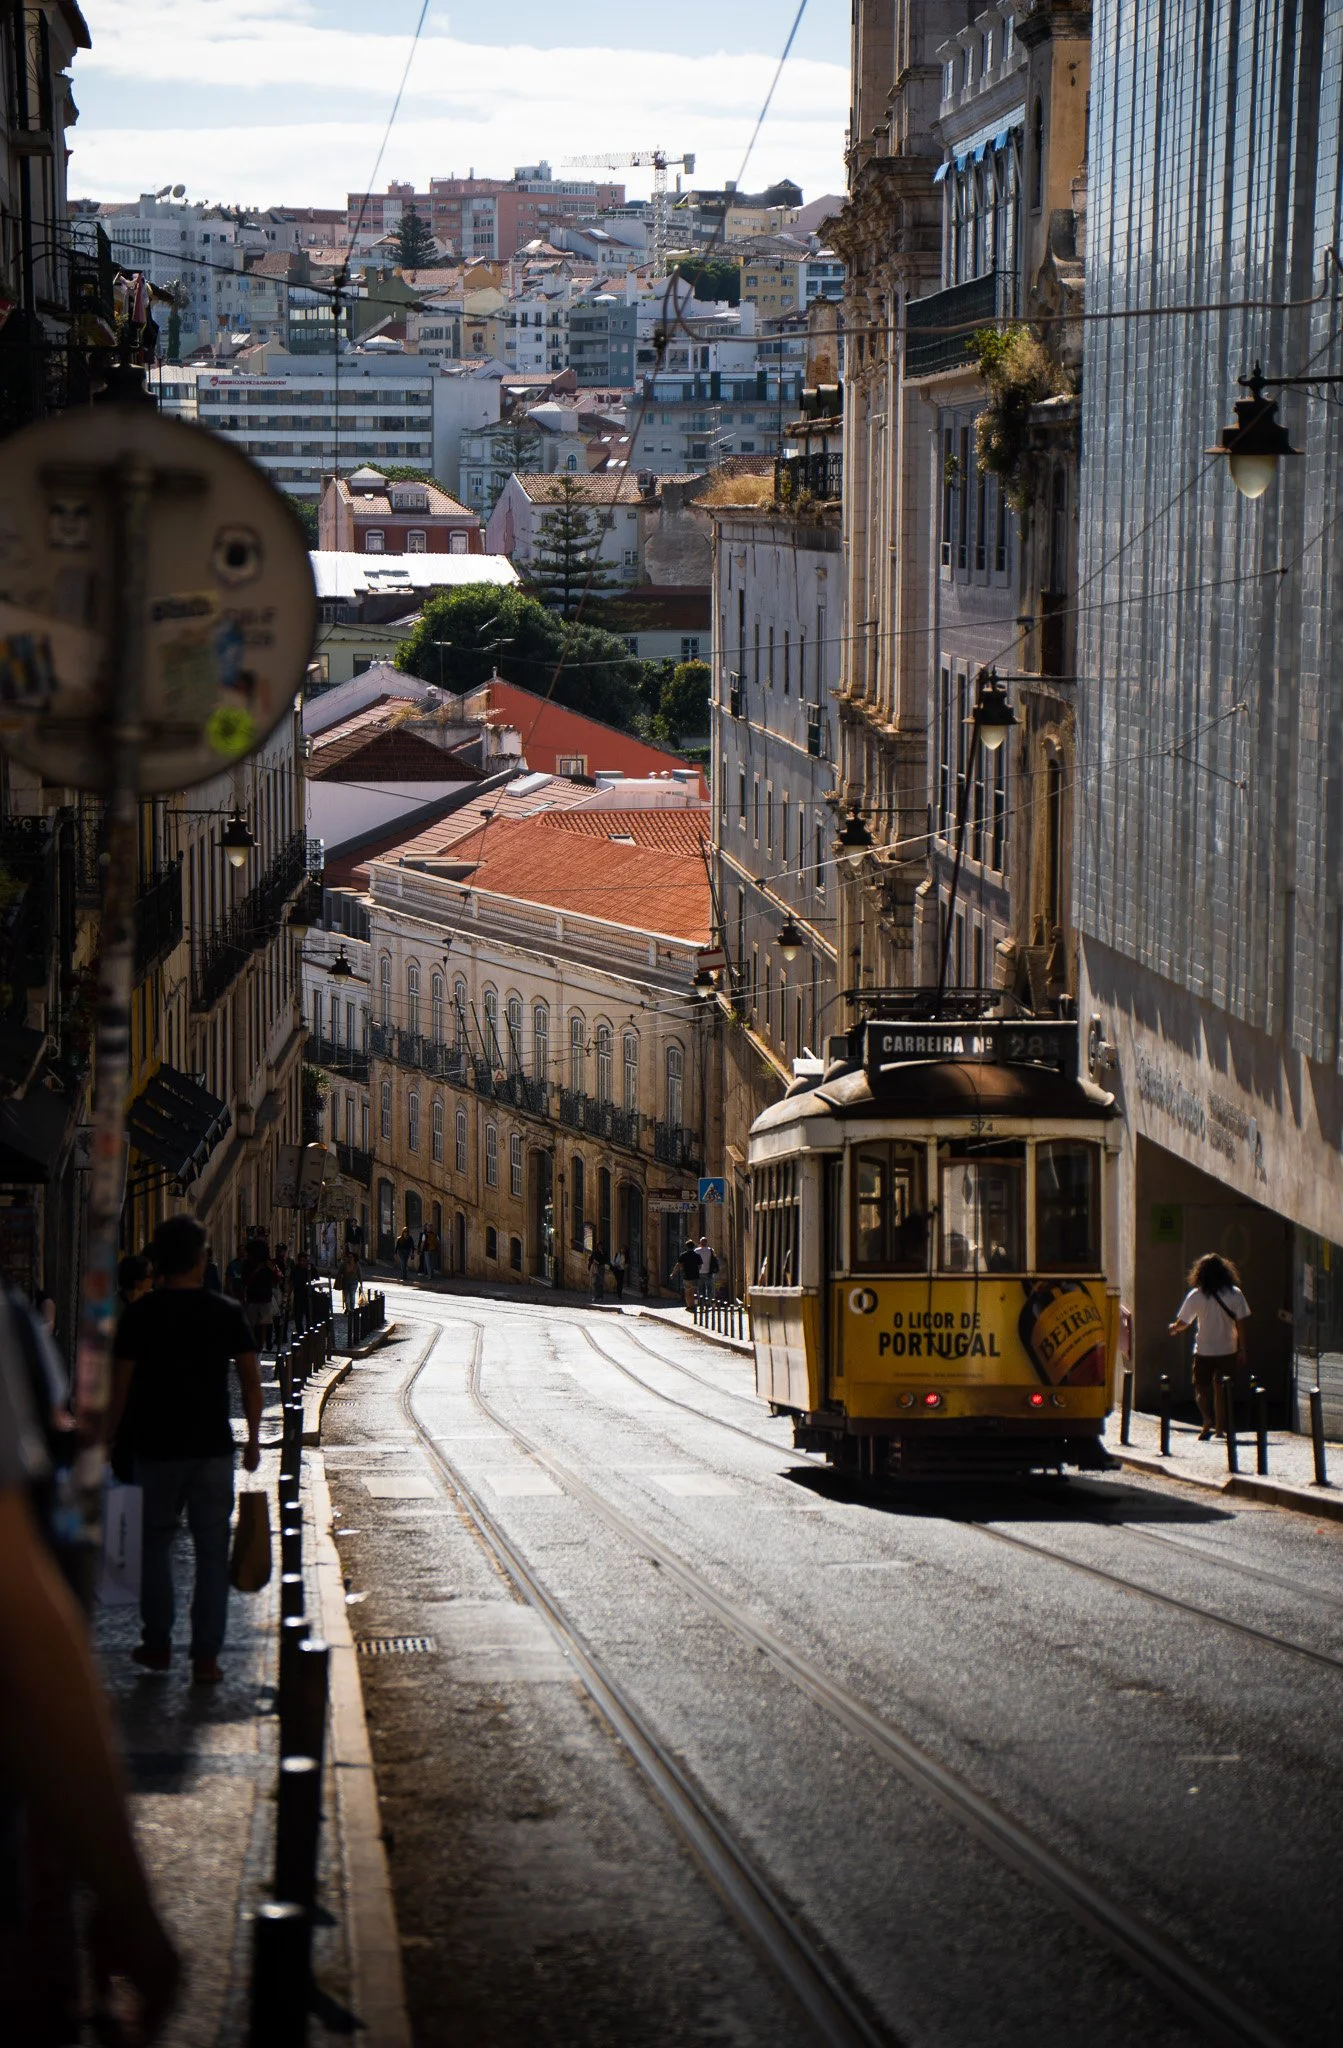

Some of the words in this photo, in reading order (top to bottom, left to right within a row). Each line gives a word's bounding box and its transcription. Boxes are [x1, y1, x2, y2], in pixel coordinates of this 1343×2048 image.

[882, 1036, 964, 1053] CARREIRA
[973, 1036, 993, 1053] Nº
[971, 1120, 993, 1132] 574
[894, 1312, 903, 1328] O
[961, 1312, 981, 1328] DE
[879, 1333, 1001, 1358] PORTUGAL
